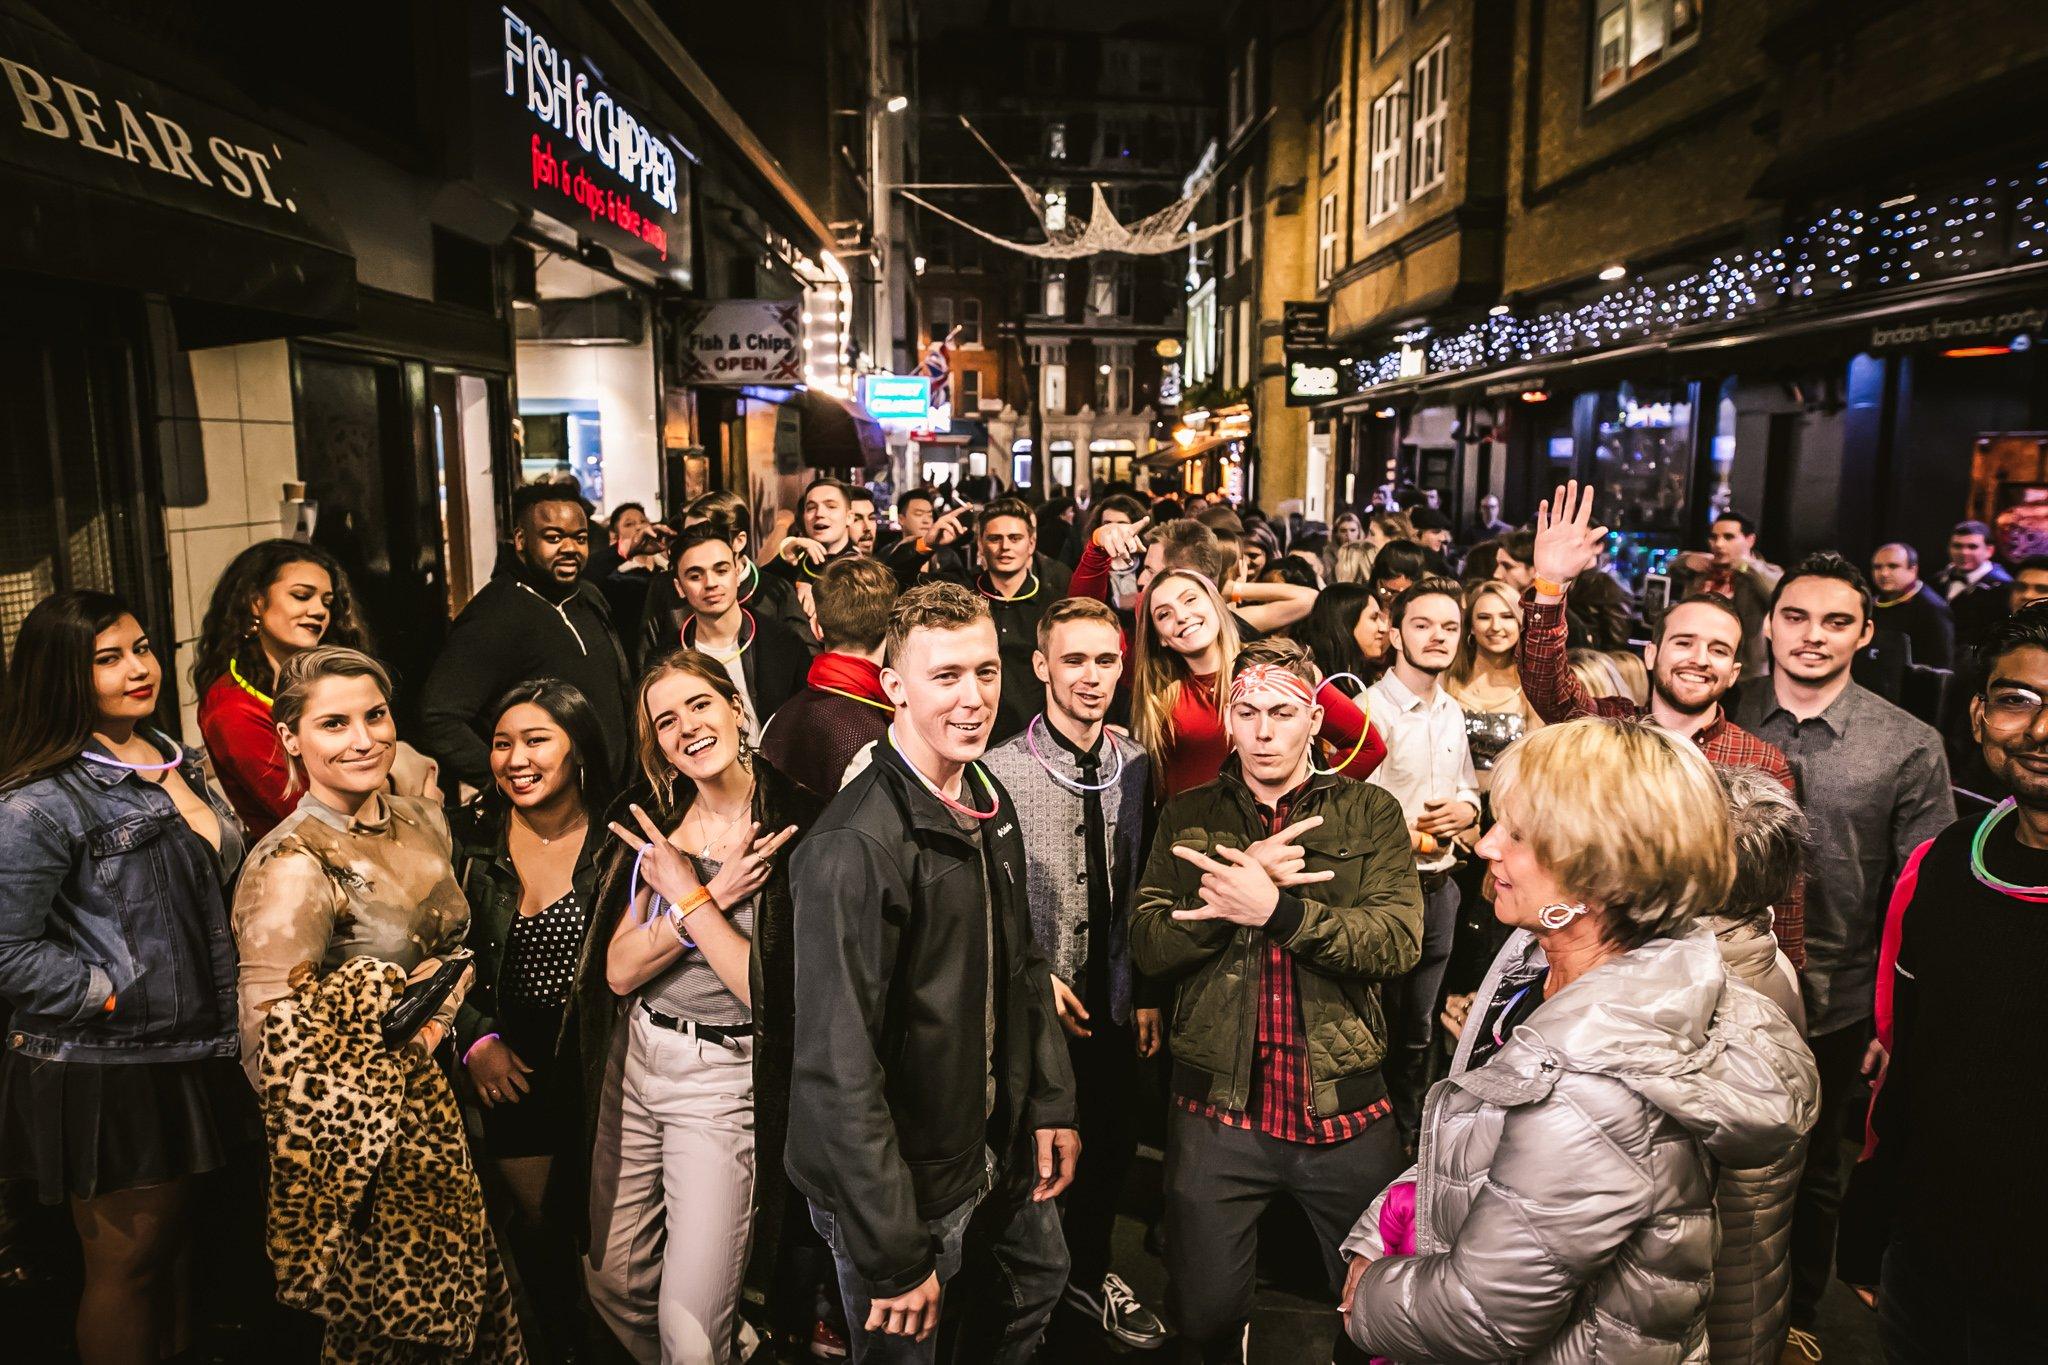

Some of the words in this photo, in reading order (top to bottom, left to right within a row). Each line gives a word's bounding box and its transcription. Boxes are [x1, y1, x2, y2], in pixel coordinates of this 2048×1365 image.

[501, 5, 573, 139] FISH
[0, 57, 214, 187] BEAR
[531, 133, 559, 190] fish
[573, 166, 606, 221] chips
[689, 332, 724, 351] Fish
[729, 333, 741, 351] &
[746, 332, 792, 354] Chips
[714, 356, 767, 371] OPEN
